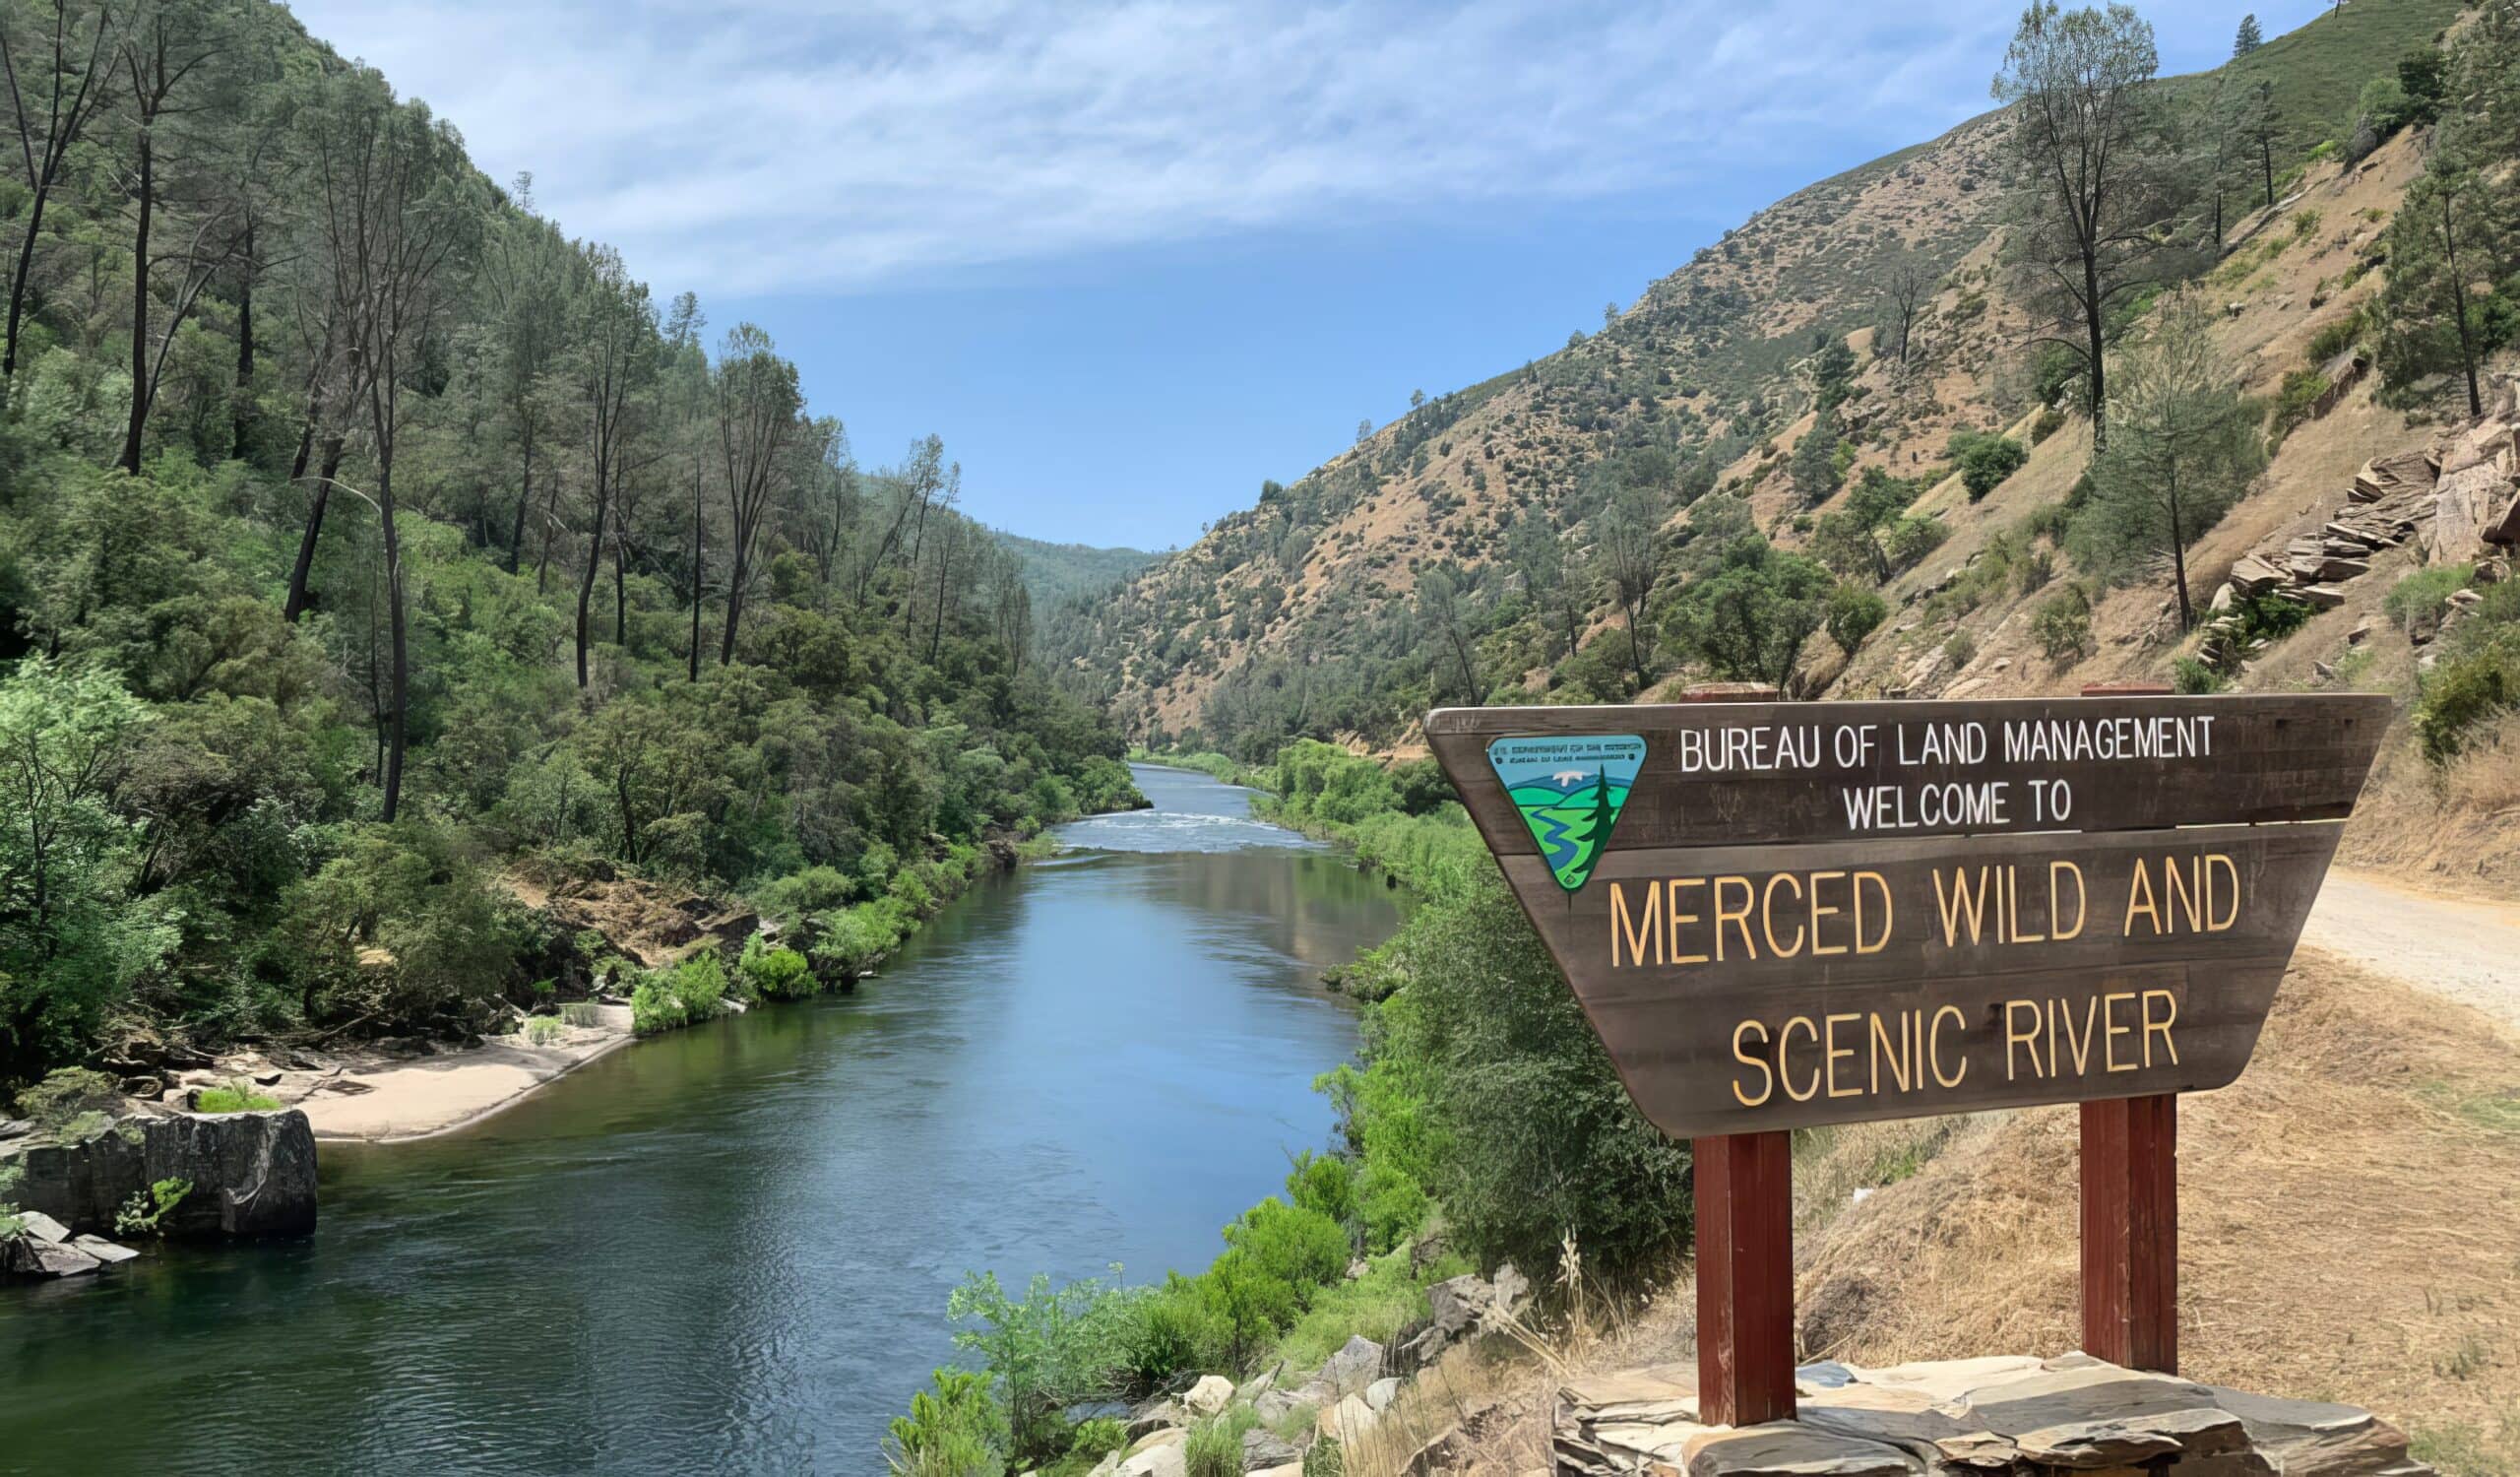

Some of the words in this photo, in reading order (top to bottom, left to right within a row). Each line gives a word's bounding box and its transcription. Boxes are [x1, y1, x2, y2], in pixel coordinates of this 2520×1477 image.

[1681, 726, 1819, 772] BUREAU
[1835, 725, 1877, 768] OF
[1899, 722, 1986, 765] LAND
[2005, 716, 2215, 762] MANAGEMENT
[1843, 782, 2010, 829] WELCOME
[2029, 779, 2071, 822] TO
[1609, 871, 1893, 968] MERCED
[1932, 861, 2086, 948] WILD
[2124, 854, 2239, 936] AND
[1732, 1004, 1968, 1107] SCENIC
[2005, 990, 2178, 1080] RIVER
